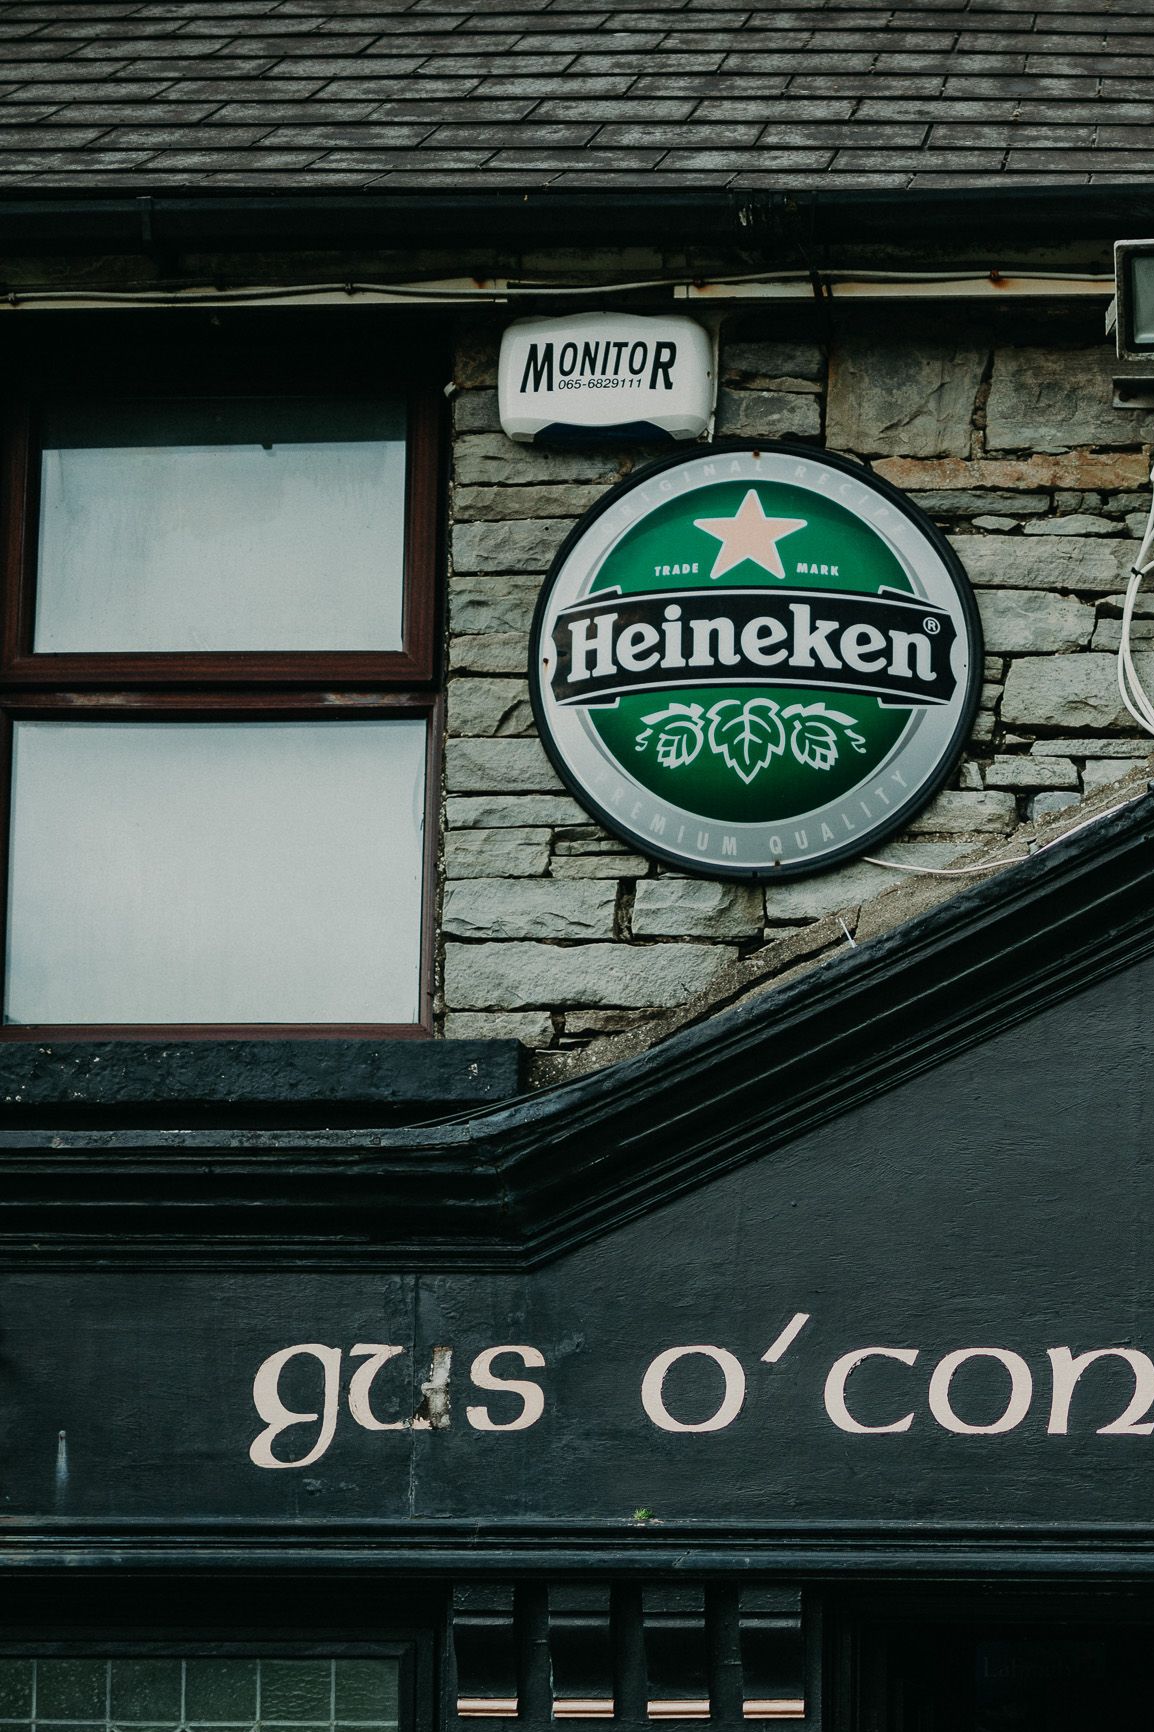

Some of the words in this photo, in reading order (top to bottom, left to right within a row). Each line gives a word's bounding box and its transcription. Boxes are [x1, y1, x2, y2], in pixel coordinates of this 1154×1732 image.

[520, 341, 677, 393] MONITOR
[558, 378, 642, 389] 065-6829111
[655, 563, 699, 576] TRADE
[796, 563, 839, 576] MARK
[567, 604, 937, 682] Heineken
[594, 771, 737, 856] PREMIUM
[769, 770, 909, 855] QUALITY
[249, 1343, 545, 1469] gus
